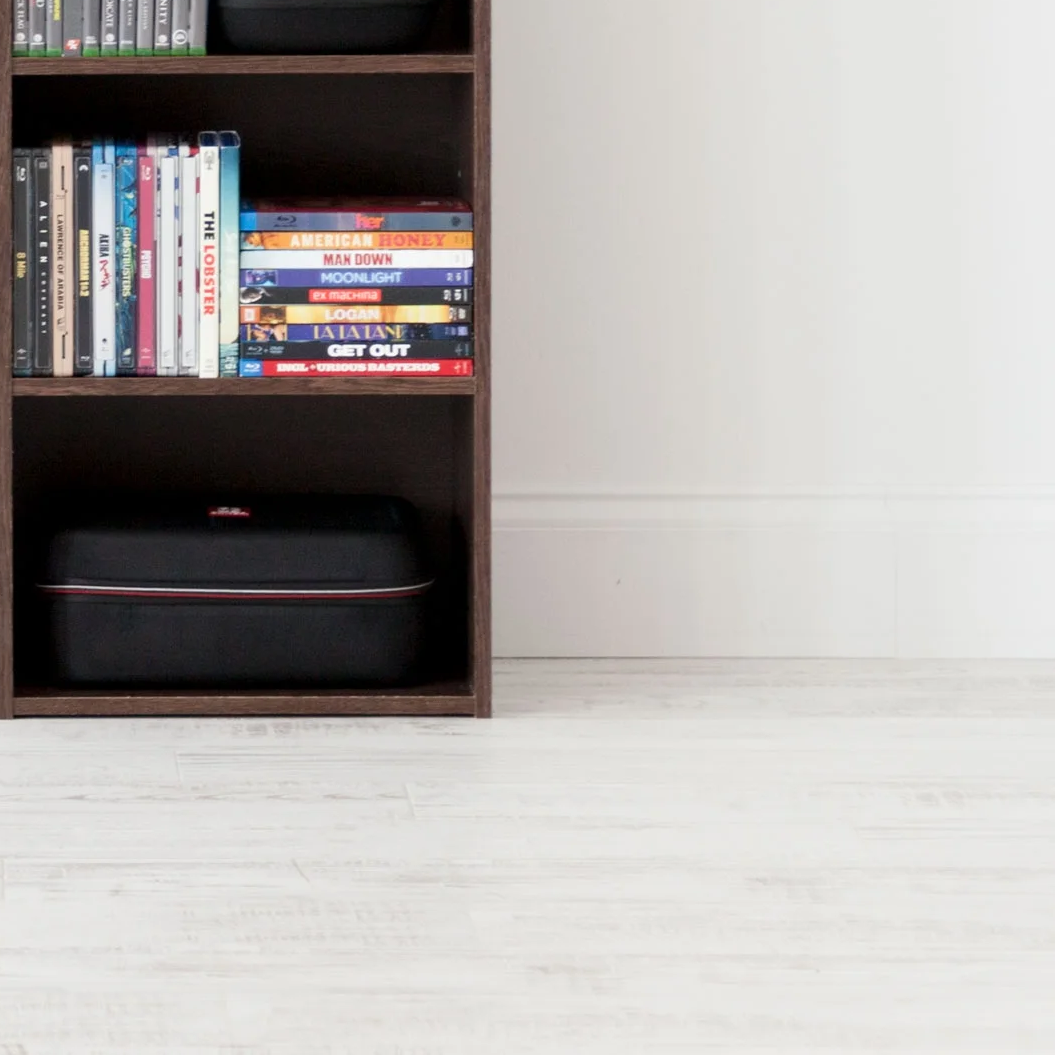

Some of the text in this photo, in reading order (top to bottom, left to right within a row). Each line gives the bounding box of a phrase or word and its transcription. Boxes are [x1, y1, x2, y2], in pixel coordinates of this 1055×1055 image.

[17, 10, 25, 29] FLAG
[355, 214, 385, 229] her
[289, 233, 445, 247] AMERICAN HONEY
[57, 214, 65, 310] LAWRENCE OF ARABIA
[78, 229, 90, 280] ANCHORMAN
[121, 227, 132, 297] GHOSTBUSTERS
[323, 253, 393, 266] MAN DOWN
[16, 260, 26, 279] Mile
[39, 201, 48, 334] ALIEN COVENANT
[140, 250, 152, 279] PSYCHO
[203, 211, 216, 315] THE LOBSTER
[321, 272, 402, 283] MOONLIGHT
[312, 291, 327, 301] ex
[325, 309, 380, 321] LOGAN
[313, 324, 404, 340] LA LA LAND
[327, 344, 411, 357] GET OUT
[367, 362, 441, 373] BASTERDS
